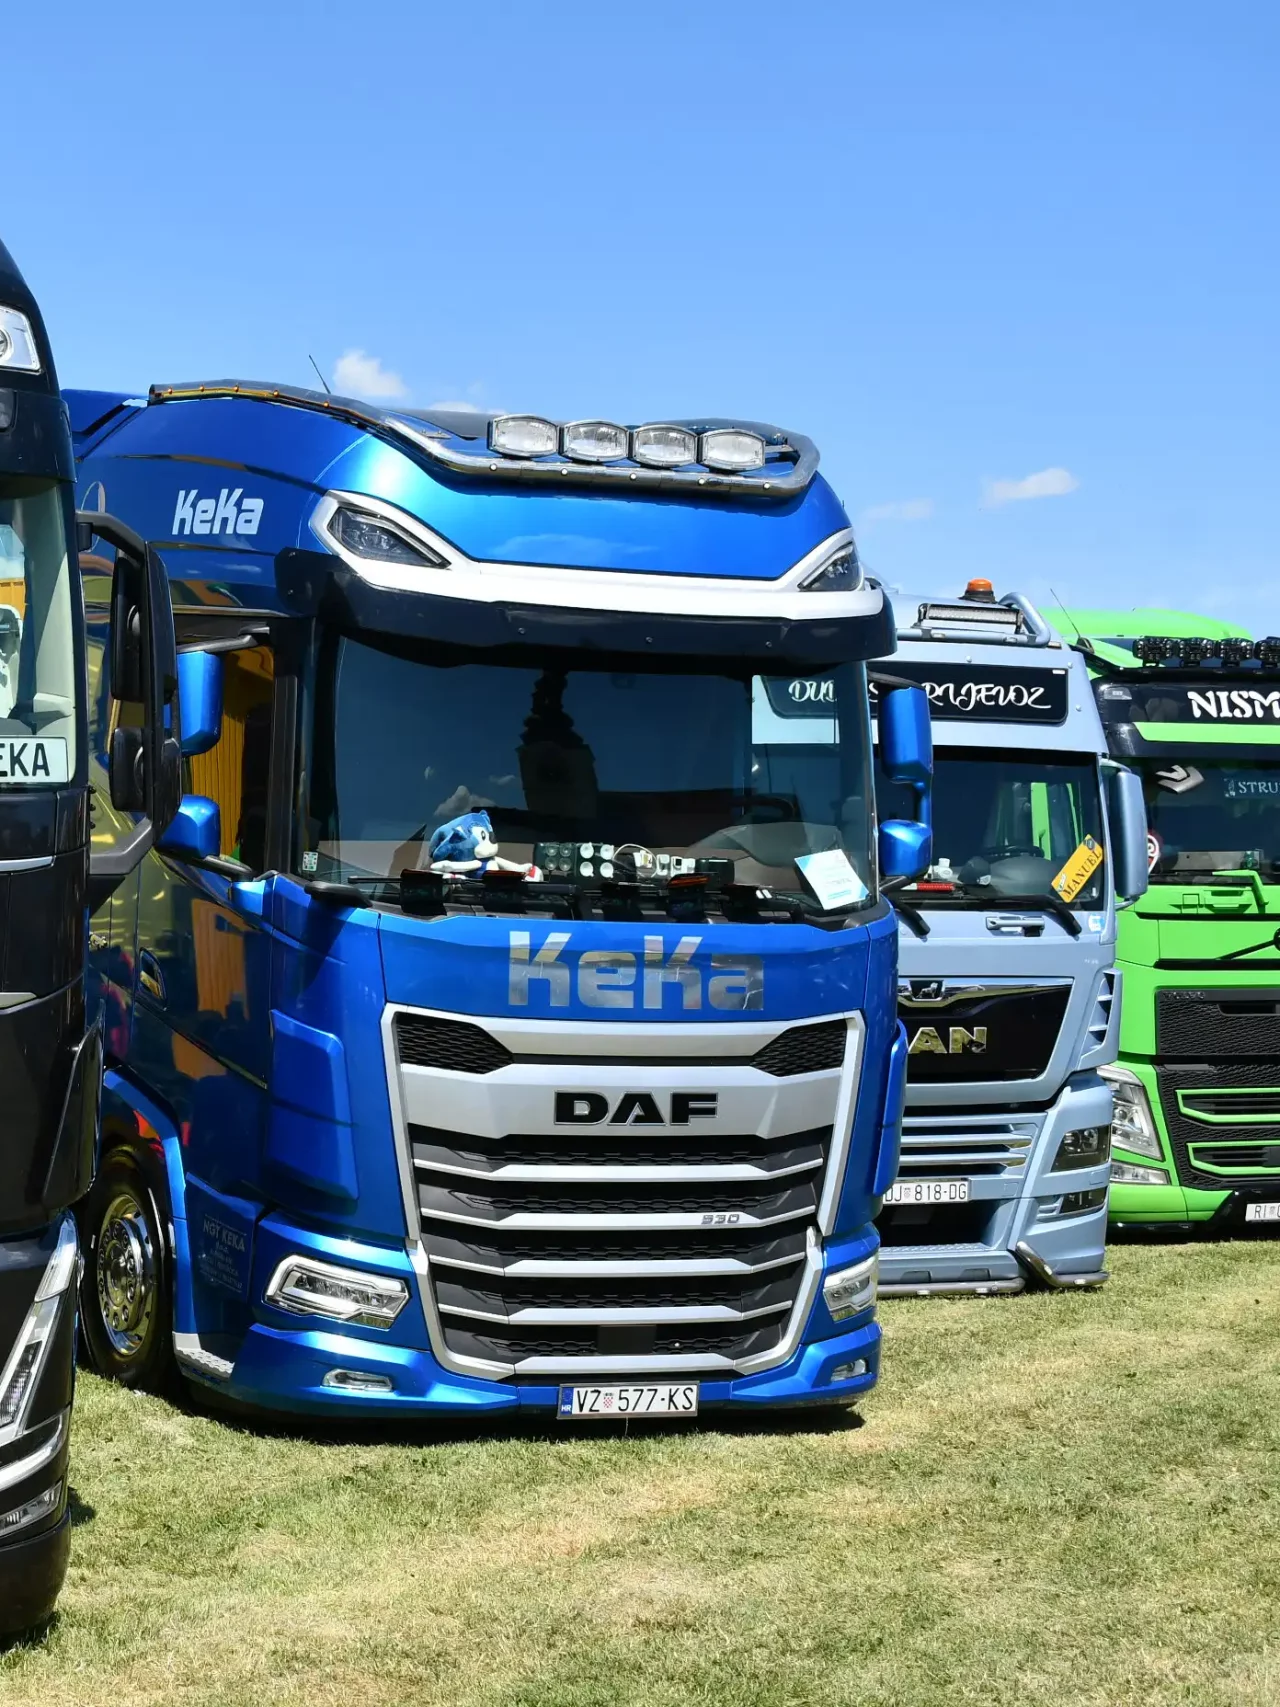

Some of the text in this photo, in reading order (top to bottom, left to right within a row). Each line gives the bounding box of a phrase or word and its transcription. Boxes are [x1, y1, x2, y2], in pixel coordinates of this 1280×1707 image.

[920, 681, 1052, 712] RIJEVOZ
[1238, 781, 1280, 794] STRU
[1063, 849, 1102, 898] MANUEL
[508, 930, 765, 1011] KeKa
[908, 1026, 988, 1054] AN
[553, 1090, 719, 1127] DAF
[914, 1183, 967, 1202] 818-DG
[1254, 1204, 1267, 1219] RI
[221, 1228, 246, 1253] KEKA
[560, 1404, 572, 1413] HR
[617, 1387, 694, 1413] 577-KS
